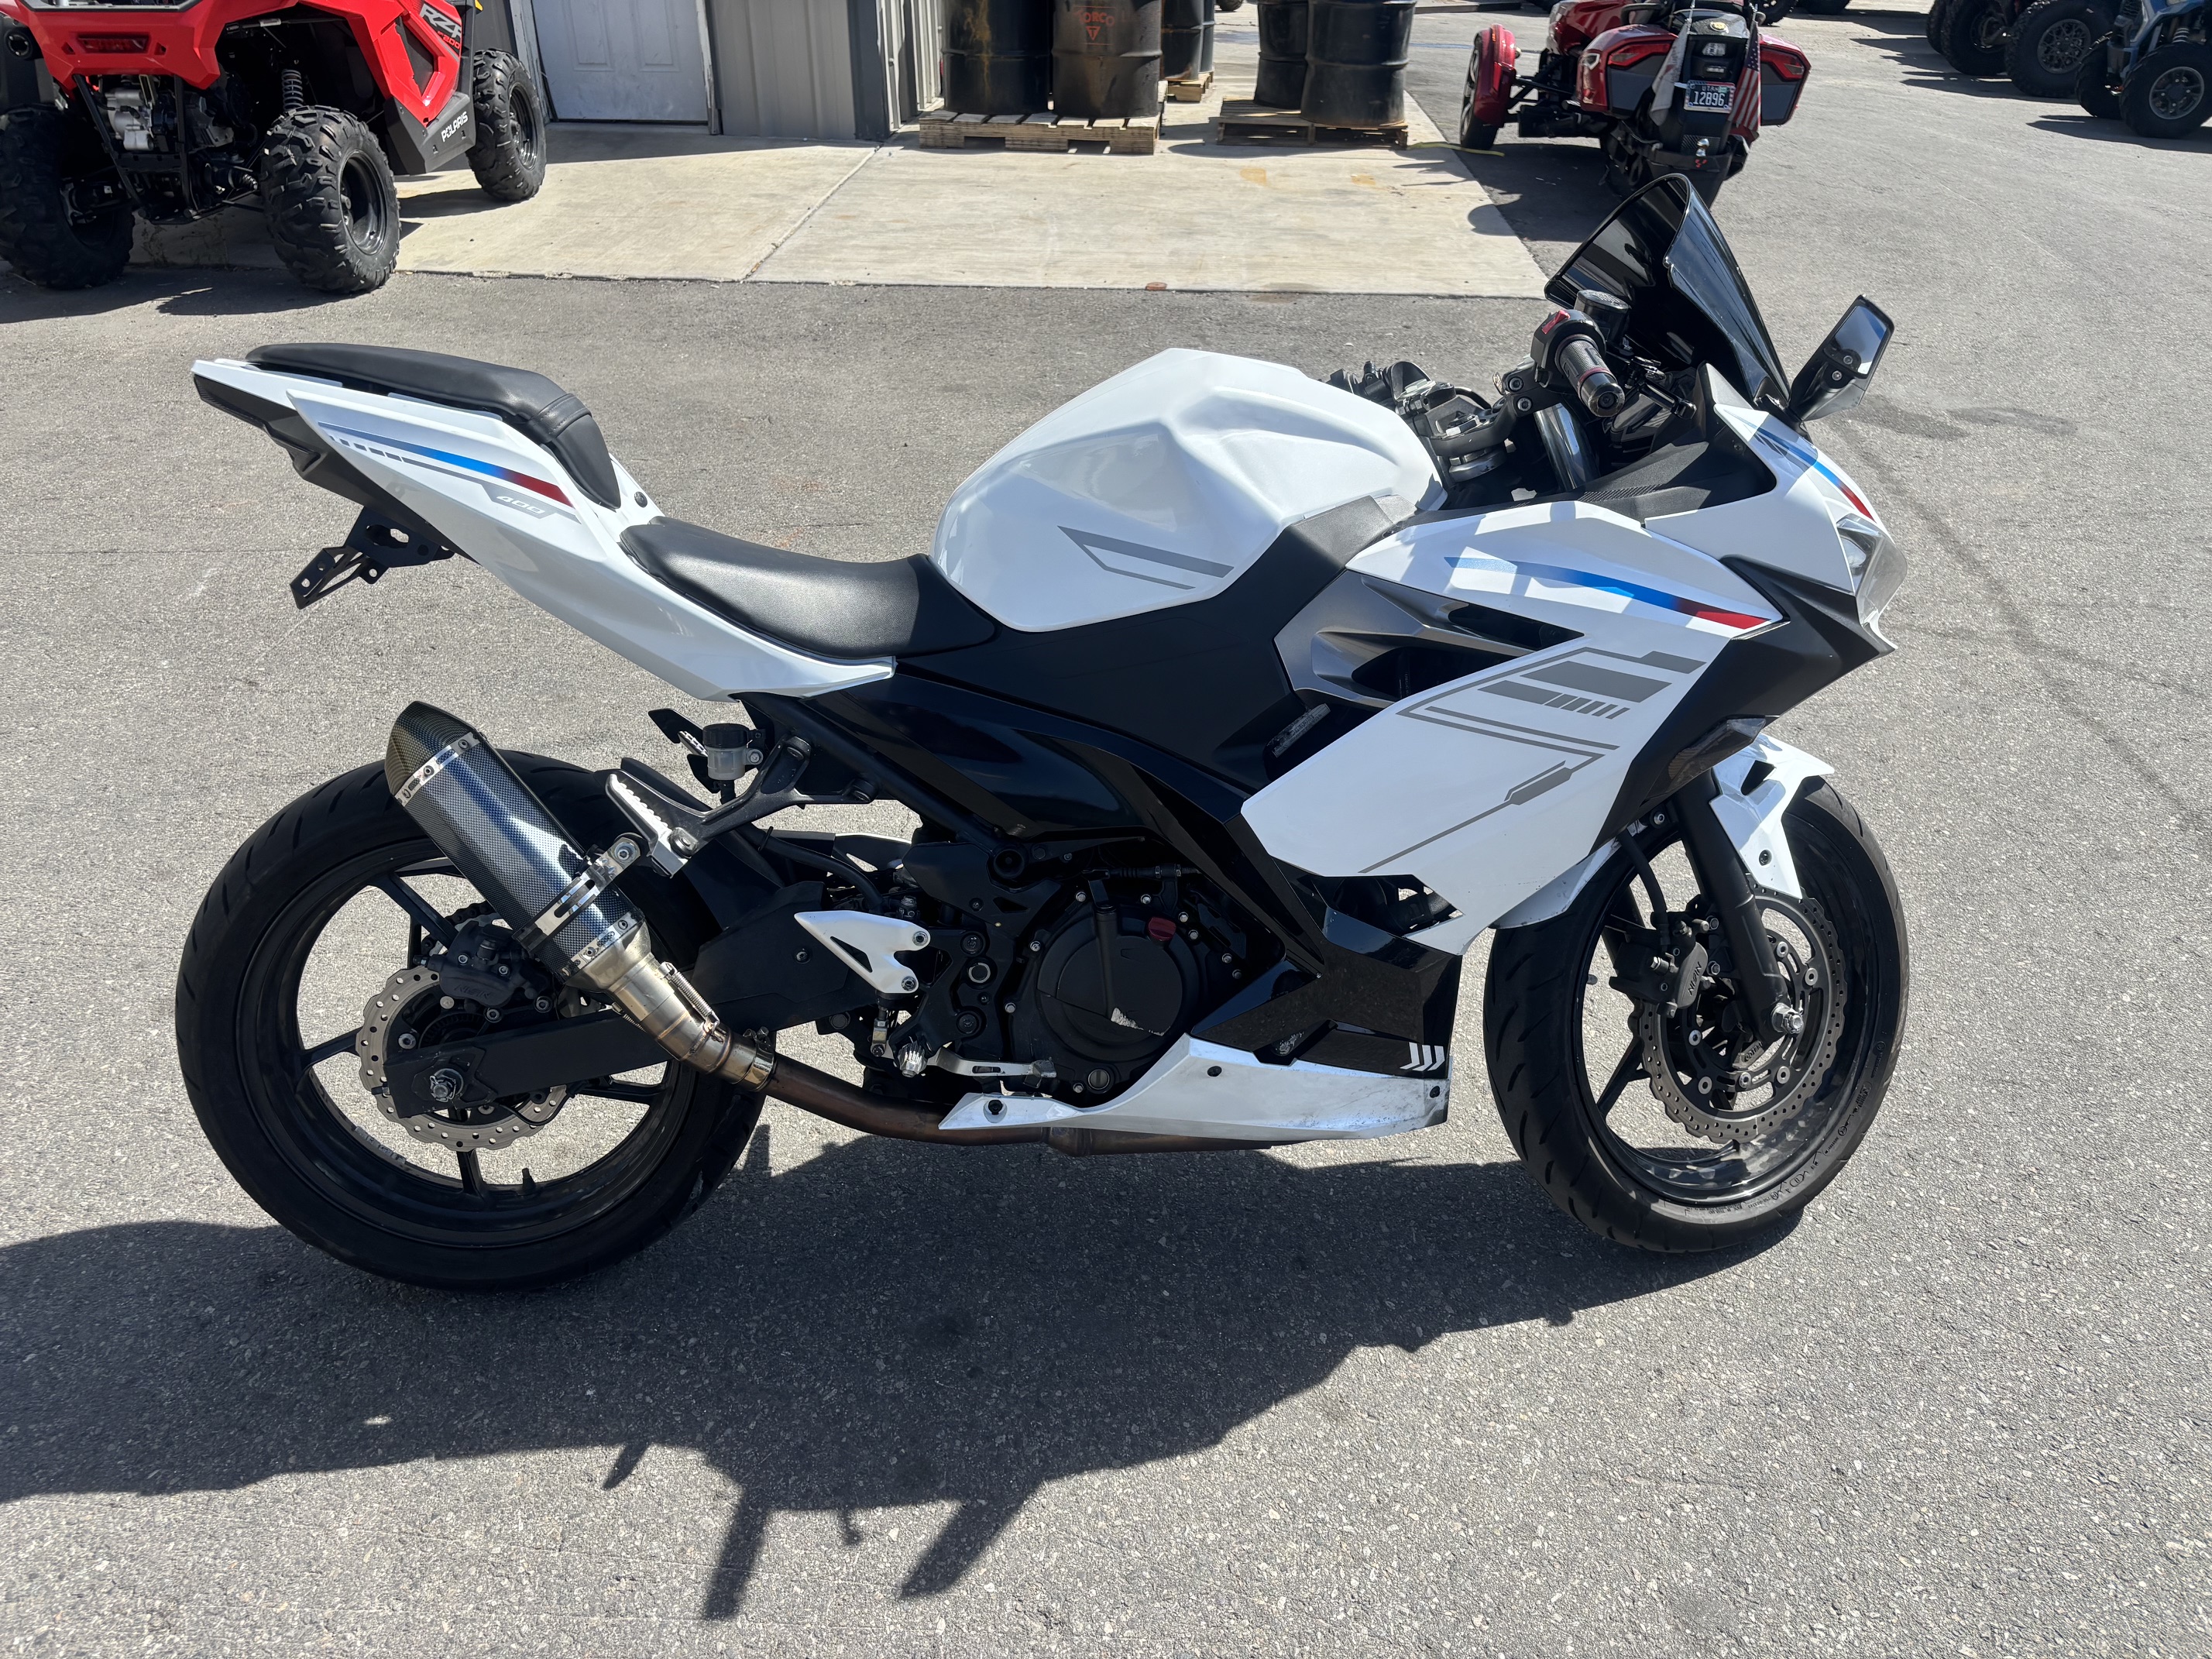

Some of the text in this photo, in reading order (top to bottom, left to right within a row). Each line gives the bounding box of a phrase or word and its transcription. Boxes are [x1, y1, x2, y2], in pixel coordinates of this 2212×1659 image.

[1693, 91, 1726, 106] 12896
[441, 111, 469, 143] POLARIS
[496, 496, 545, 514] 400
